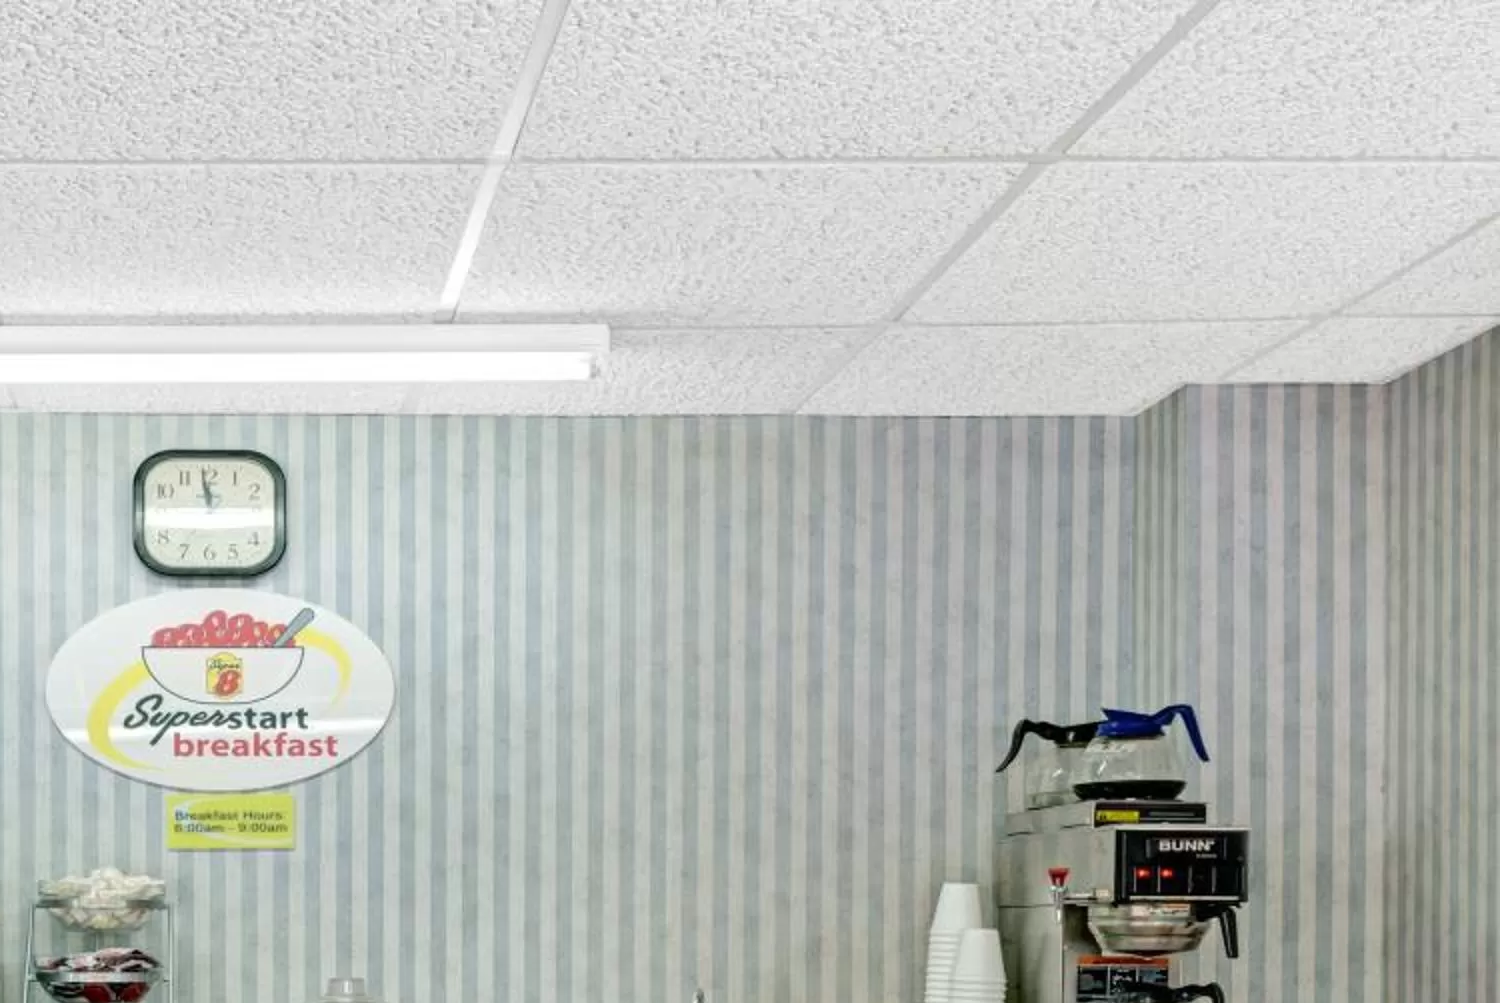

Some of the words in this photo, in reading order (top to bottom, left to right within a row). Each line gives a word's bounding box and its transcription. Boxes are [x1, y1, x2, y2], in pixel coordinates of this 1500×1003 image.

[179, 469, 192, 487] 11
[232, 470, 238, 487] 1
[247, 482, 261, 501] 2
[248, 531, 261, 547] 4
[178, 543, 191, 559] 7
[203, 543, 217, 561] 6
[227, 543, 239, 561] 5
[173, 732, 339, 758] breakfast
[174, 809, 238, 821] Breakfast
[1159, 838, 1211, 852] BUNN
